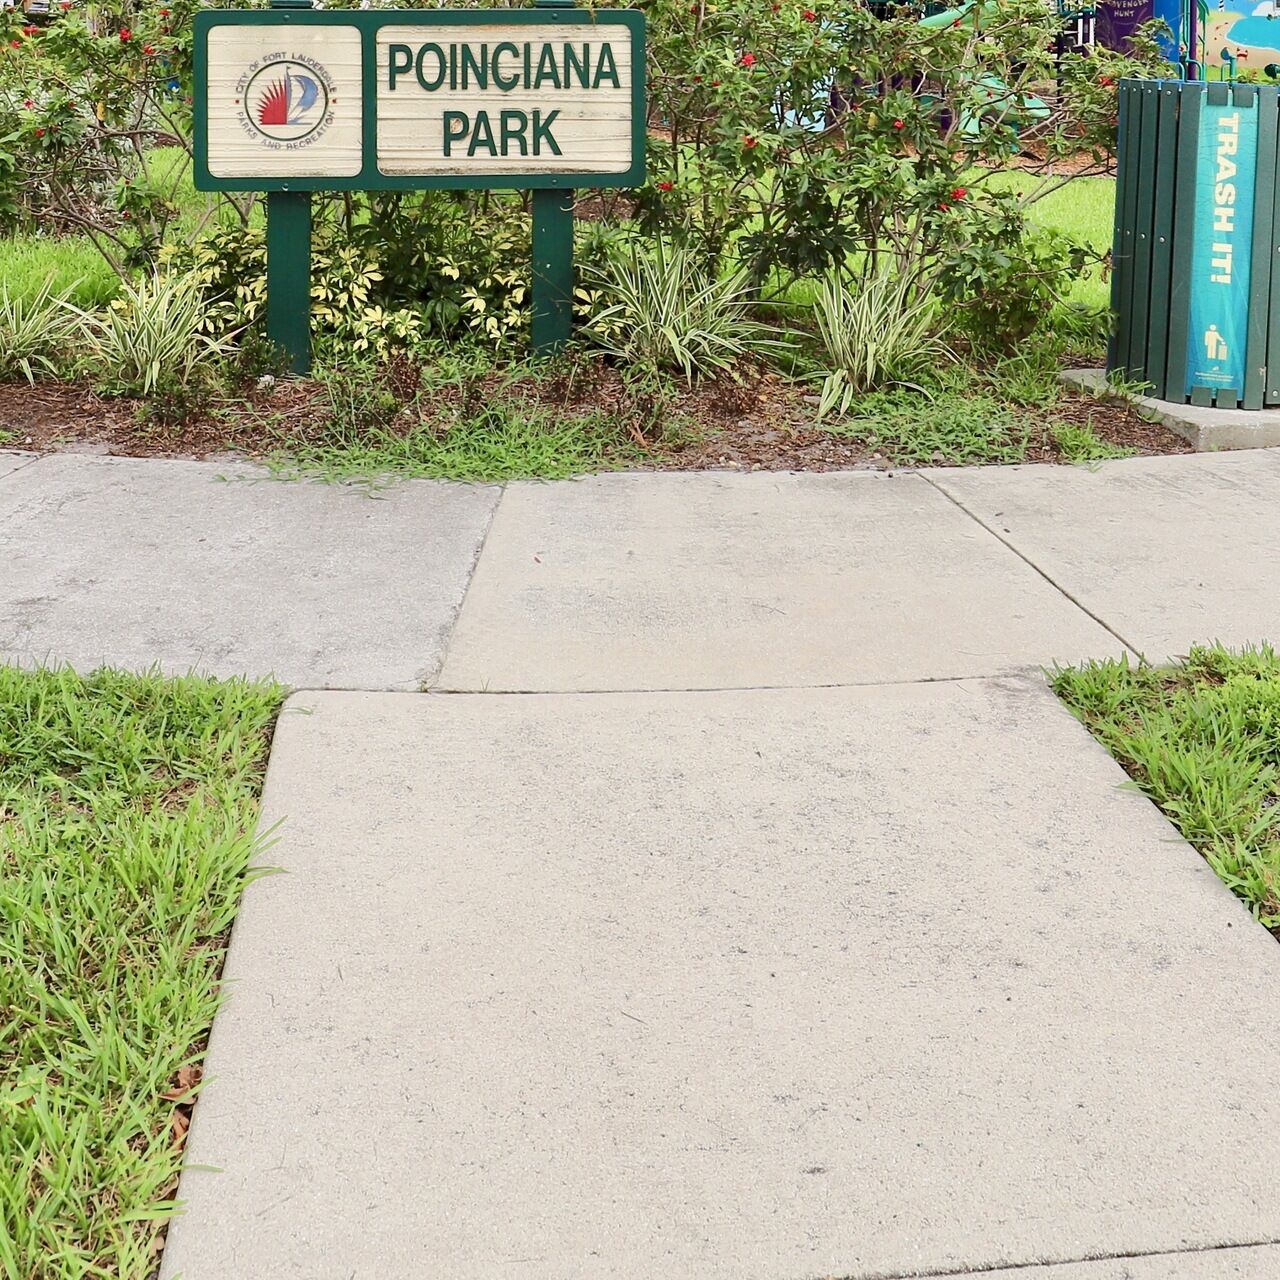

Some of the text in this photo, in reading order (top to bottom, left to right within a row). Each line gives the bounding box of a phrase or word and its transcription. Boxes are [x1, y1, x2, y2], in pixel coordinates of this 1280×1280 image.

[236, 52, 337, 93] CITY OF FORT LAUDERDALE
[388, 42, 620, 91] POINCIANA
[236, 111, 335, 150] PARKS AND RECREATION
[443, 110, 562, 157] PARK
[1211, 112, 1240, 284] TRASH IT!
